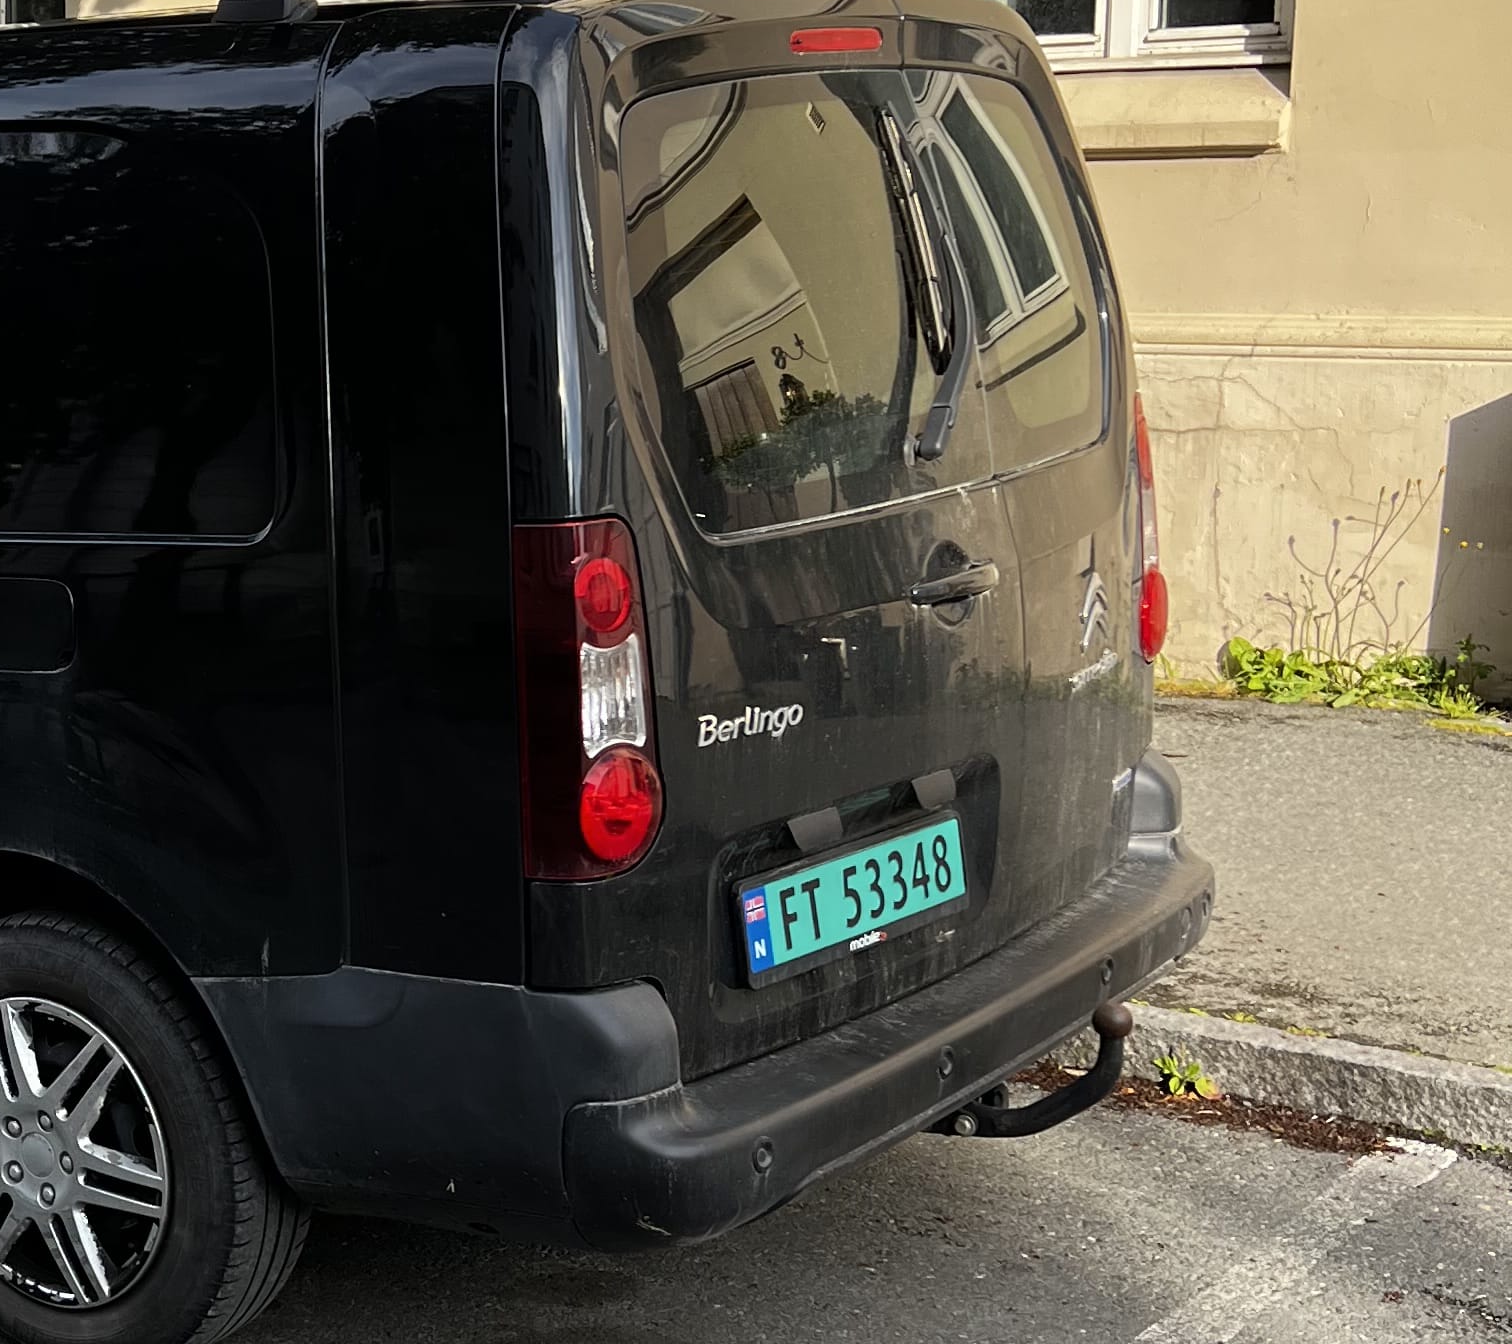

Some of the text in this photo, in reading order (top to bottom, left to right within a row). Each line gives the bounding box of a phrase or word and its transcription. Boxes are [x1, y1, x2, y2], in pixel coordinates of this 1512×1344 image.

[697, 703, 804, 747] Berlingo
[779, 834, 952, 950] FT 53348
[753, 938, 767, 959] N
